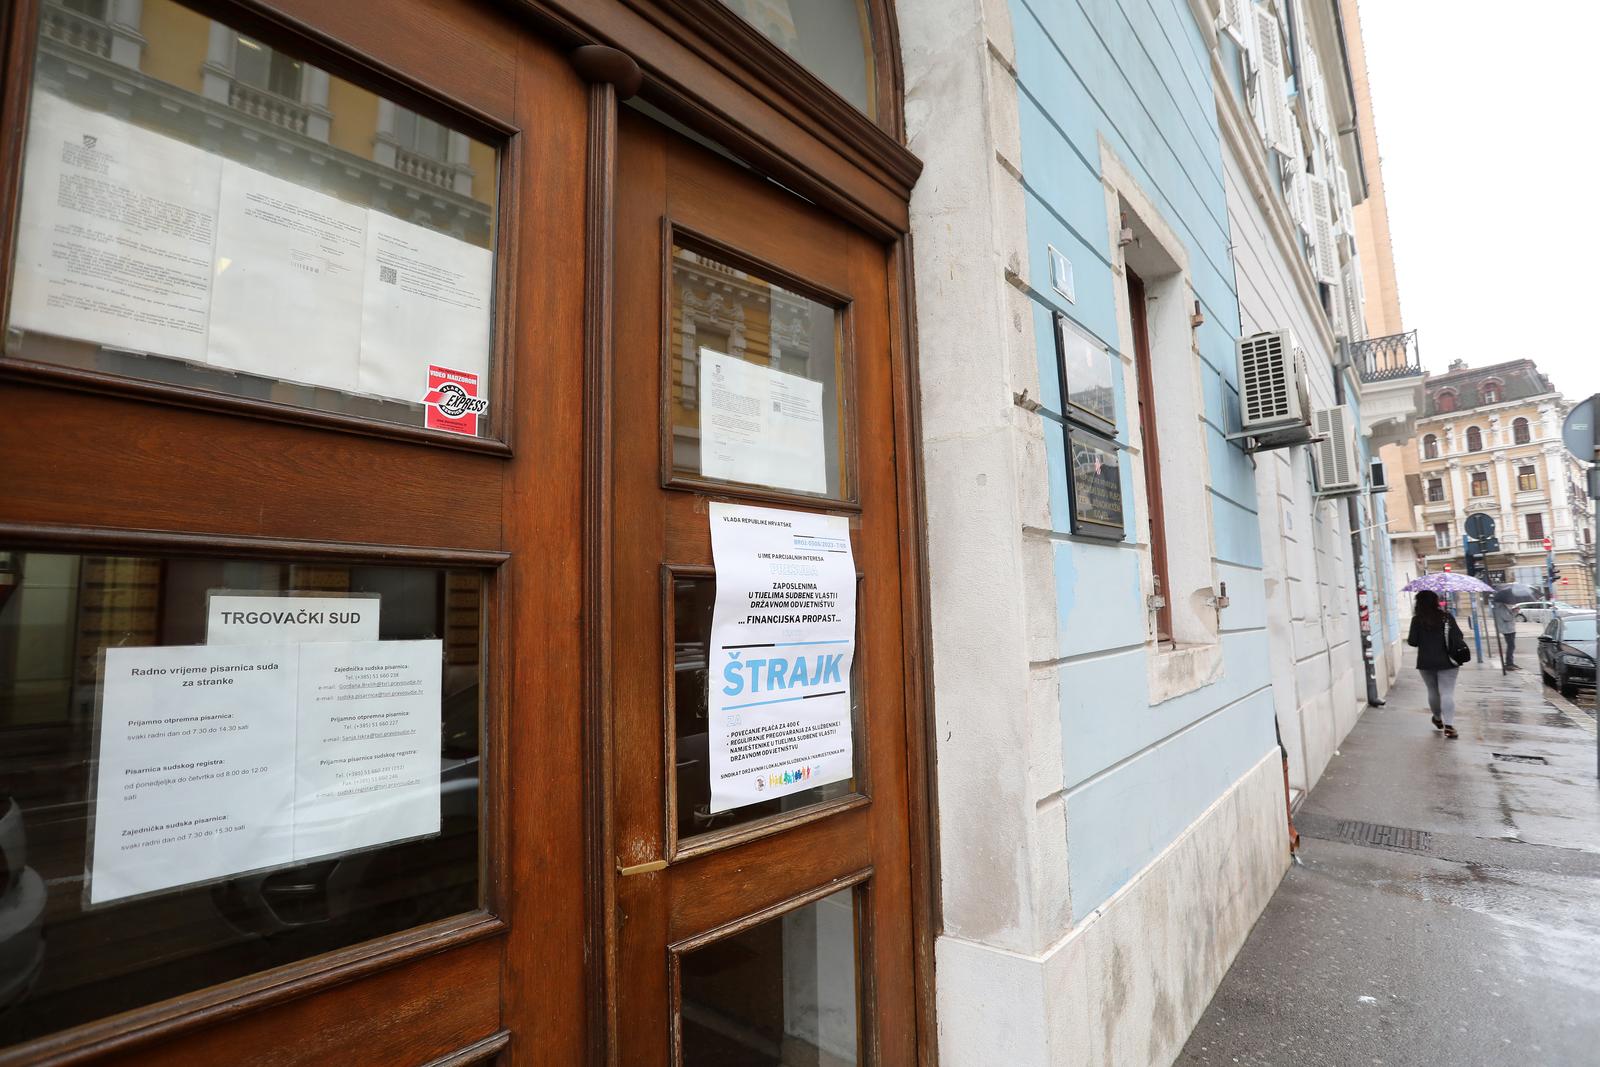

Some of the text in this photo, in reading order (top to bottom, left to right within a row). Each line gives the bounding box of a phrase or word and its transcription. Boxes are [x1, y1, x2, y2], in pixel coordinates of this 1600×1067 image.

[443, 385, 464, 396] ALARM
[446, 395, 486, 411] EXPRESS
[751, 600, 834, 608] DRŽAVNOM ODVJETNIŠTVU
[221, 609, 360, 624] TRGOVAČKI SUD
[747, 615, 801, 624] FINANCIJSKA
[132, 668, 166, 677] Radno
[170, 665, 207, 675] vrijeme
[210, 664, 254, 674] pisarnica
[722, 652, 843, 696] ŠTRAJK
[197, 677, 233, 686] stranke
[164, 716, 198, 724] otpremna
[731, 734, 765, 746] REGULIRANJE
[766, 728, 804, 740] PREGOVARANJA
[775, 736, 796, 745] TIJELIMA
[798, 733, 818, 742] SUDBENE
[125, 759, 225, 775] Pisarnica sudskog registra:
[721, 770, 741, 779] SINDIKAT
[766, 761, 786, 770] LOKALNIH
[136, 778, 176, 789] ponedjeljka
[122, 825, 164, 836] Zajednička
[166, 820, 192, 829] sudska
[142, 839, 160, 848] radni
